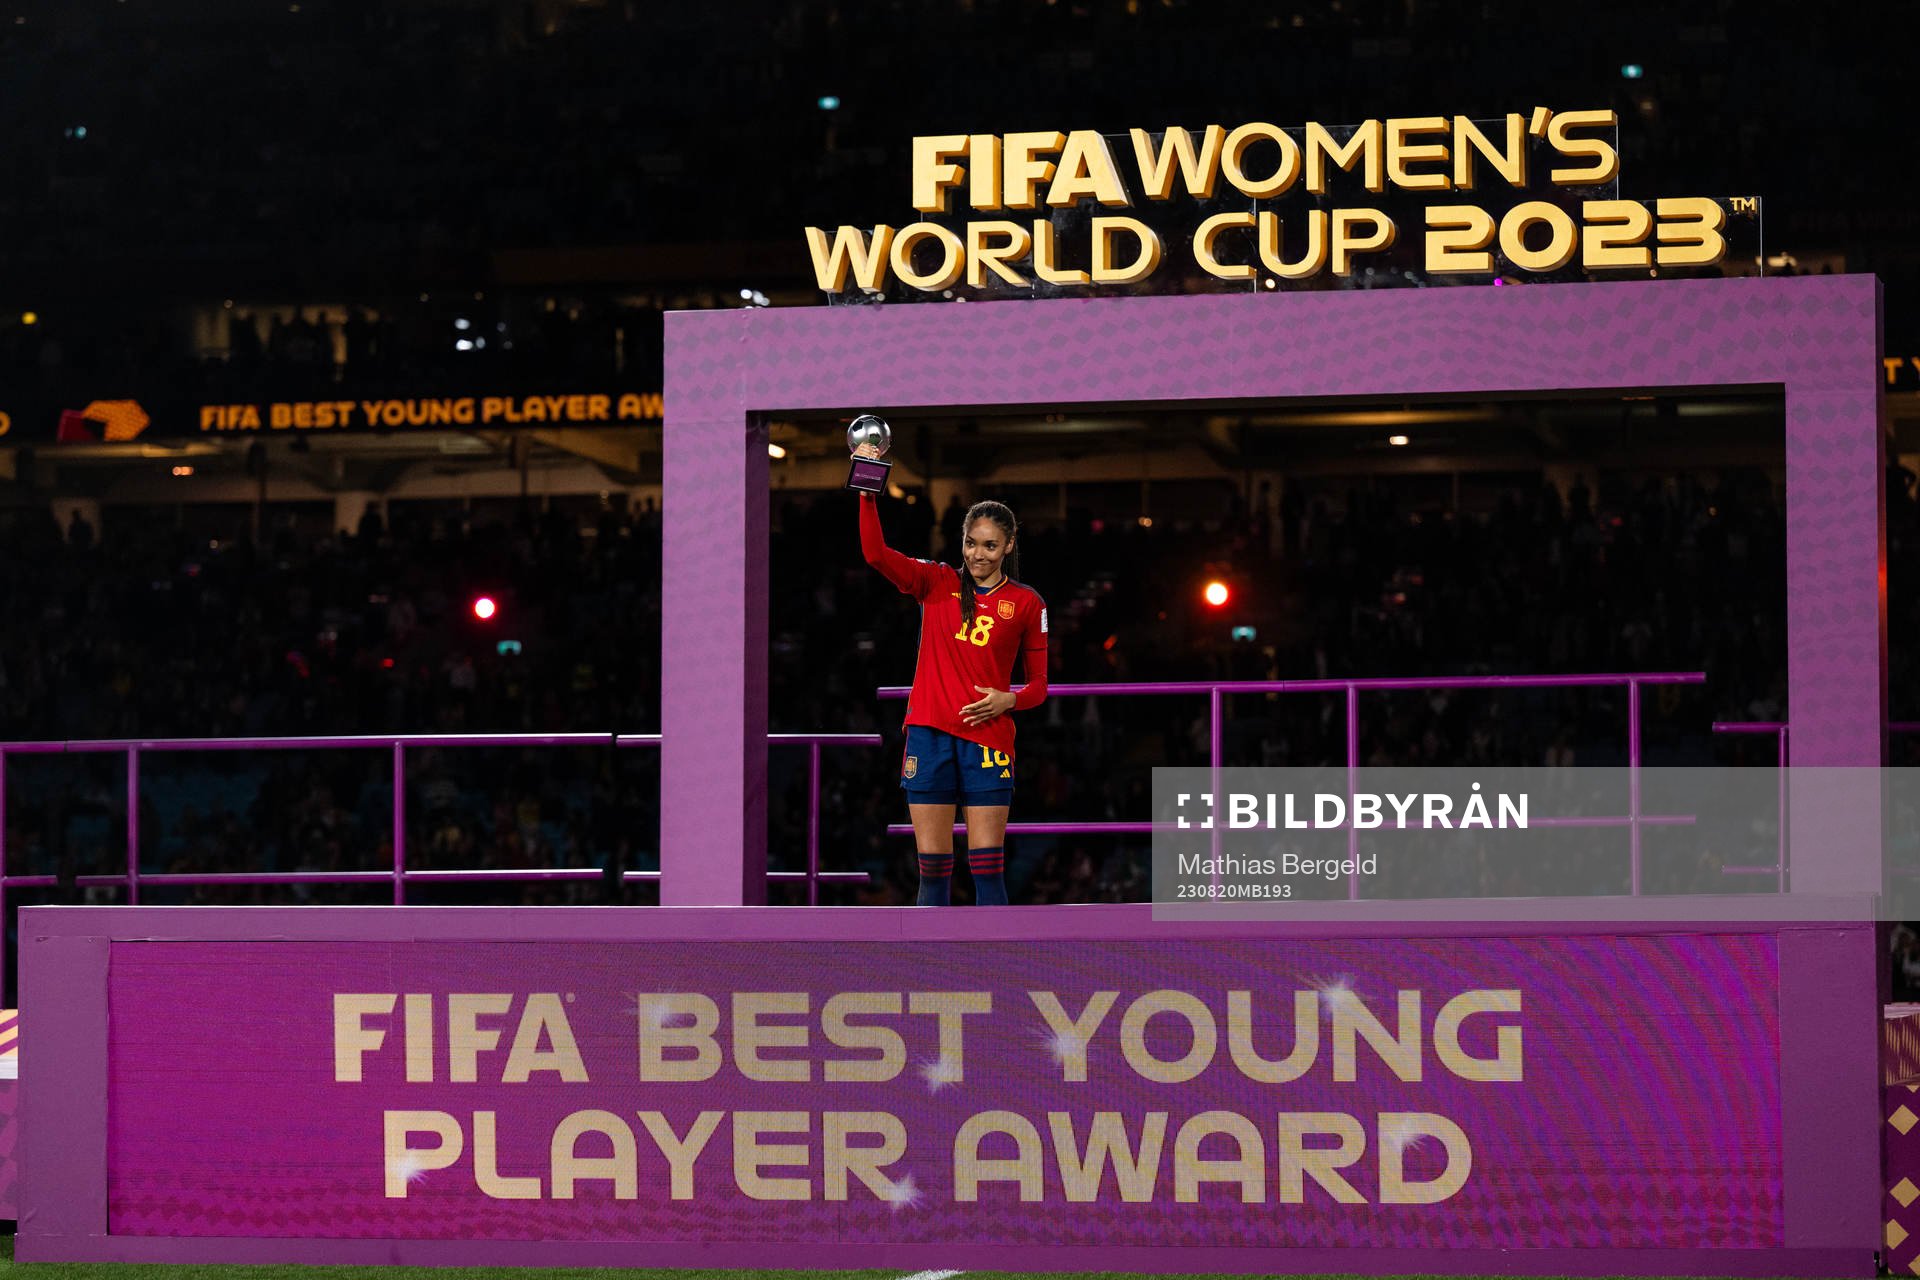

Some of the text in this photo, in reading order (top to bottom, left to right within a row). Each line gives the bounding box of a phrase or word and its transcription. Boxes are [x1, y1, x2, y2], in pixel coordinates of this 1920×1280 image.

[912, 106, 1620, 213] FIFA WOMEN'S
[804, 215, 1162, 294] WORLD
[1192, 207, 1397, 281] CUP
[1424, 196, 1728, 275] 2023
[200, 404, 261, 431] FIFA
[270, 402, 356, 429] BEST
[362, 397, 475, 426] YOUNG
[481, 393, 611, 422] PLAYER
[954, 614, 995, 647] 18
[333, 988, 1524, 1084] FIFA BEST YOUNG
[383, 1109, 1473, 1205] PLAYER AWARD
